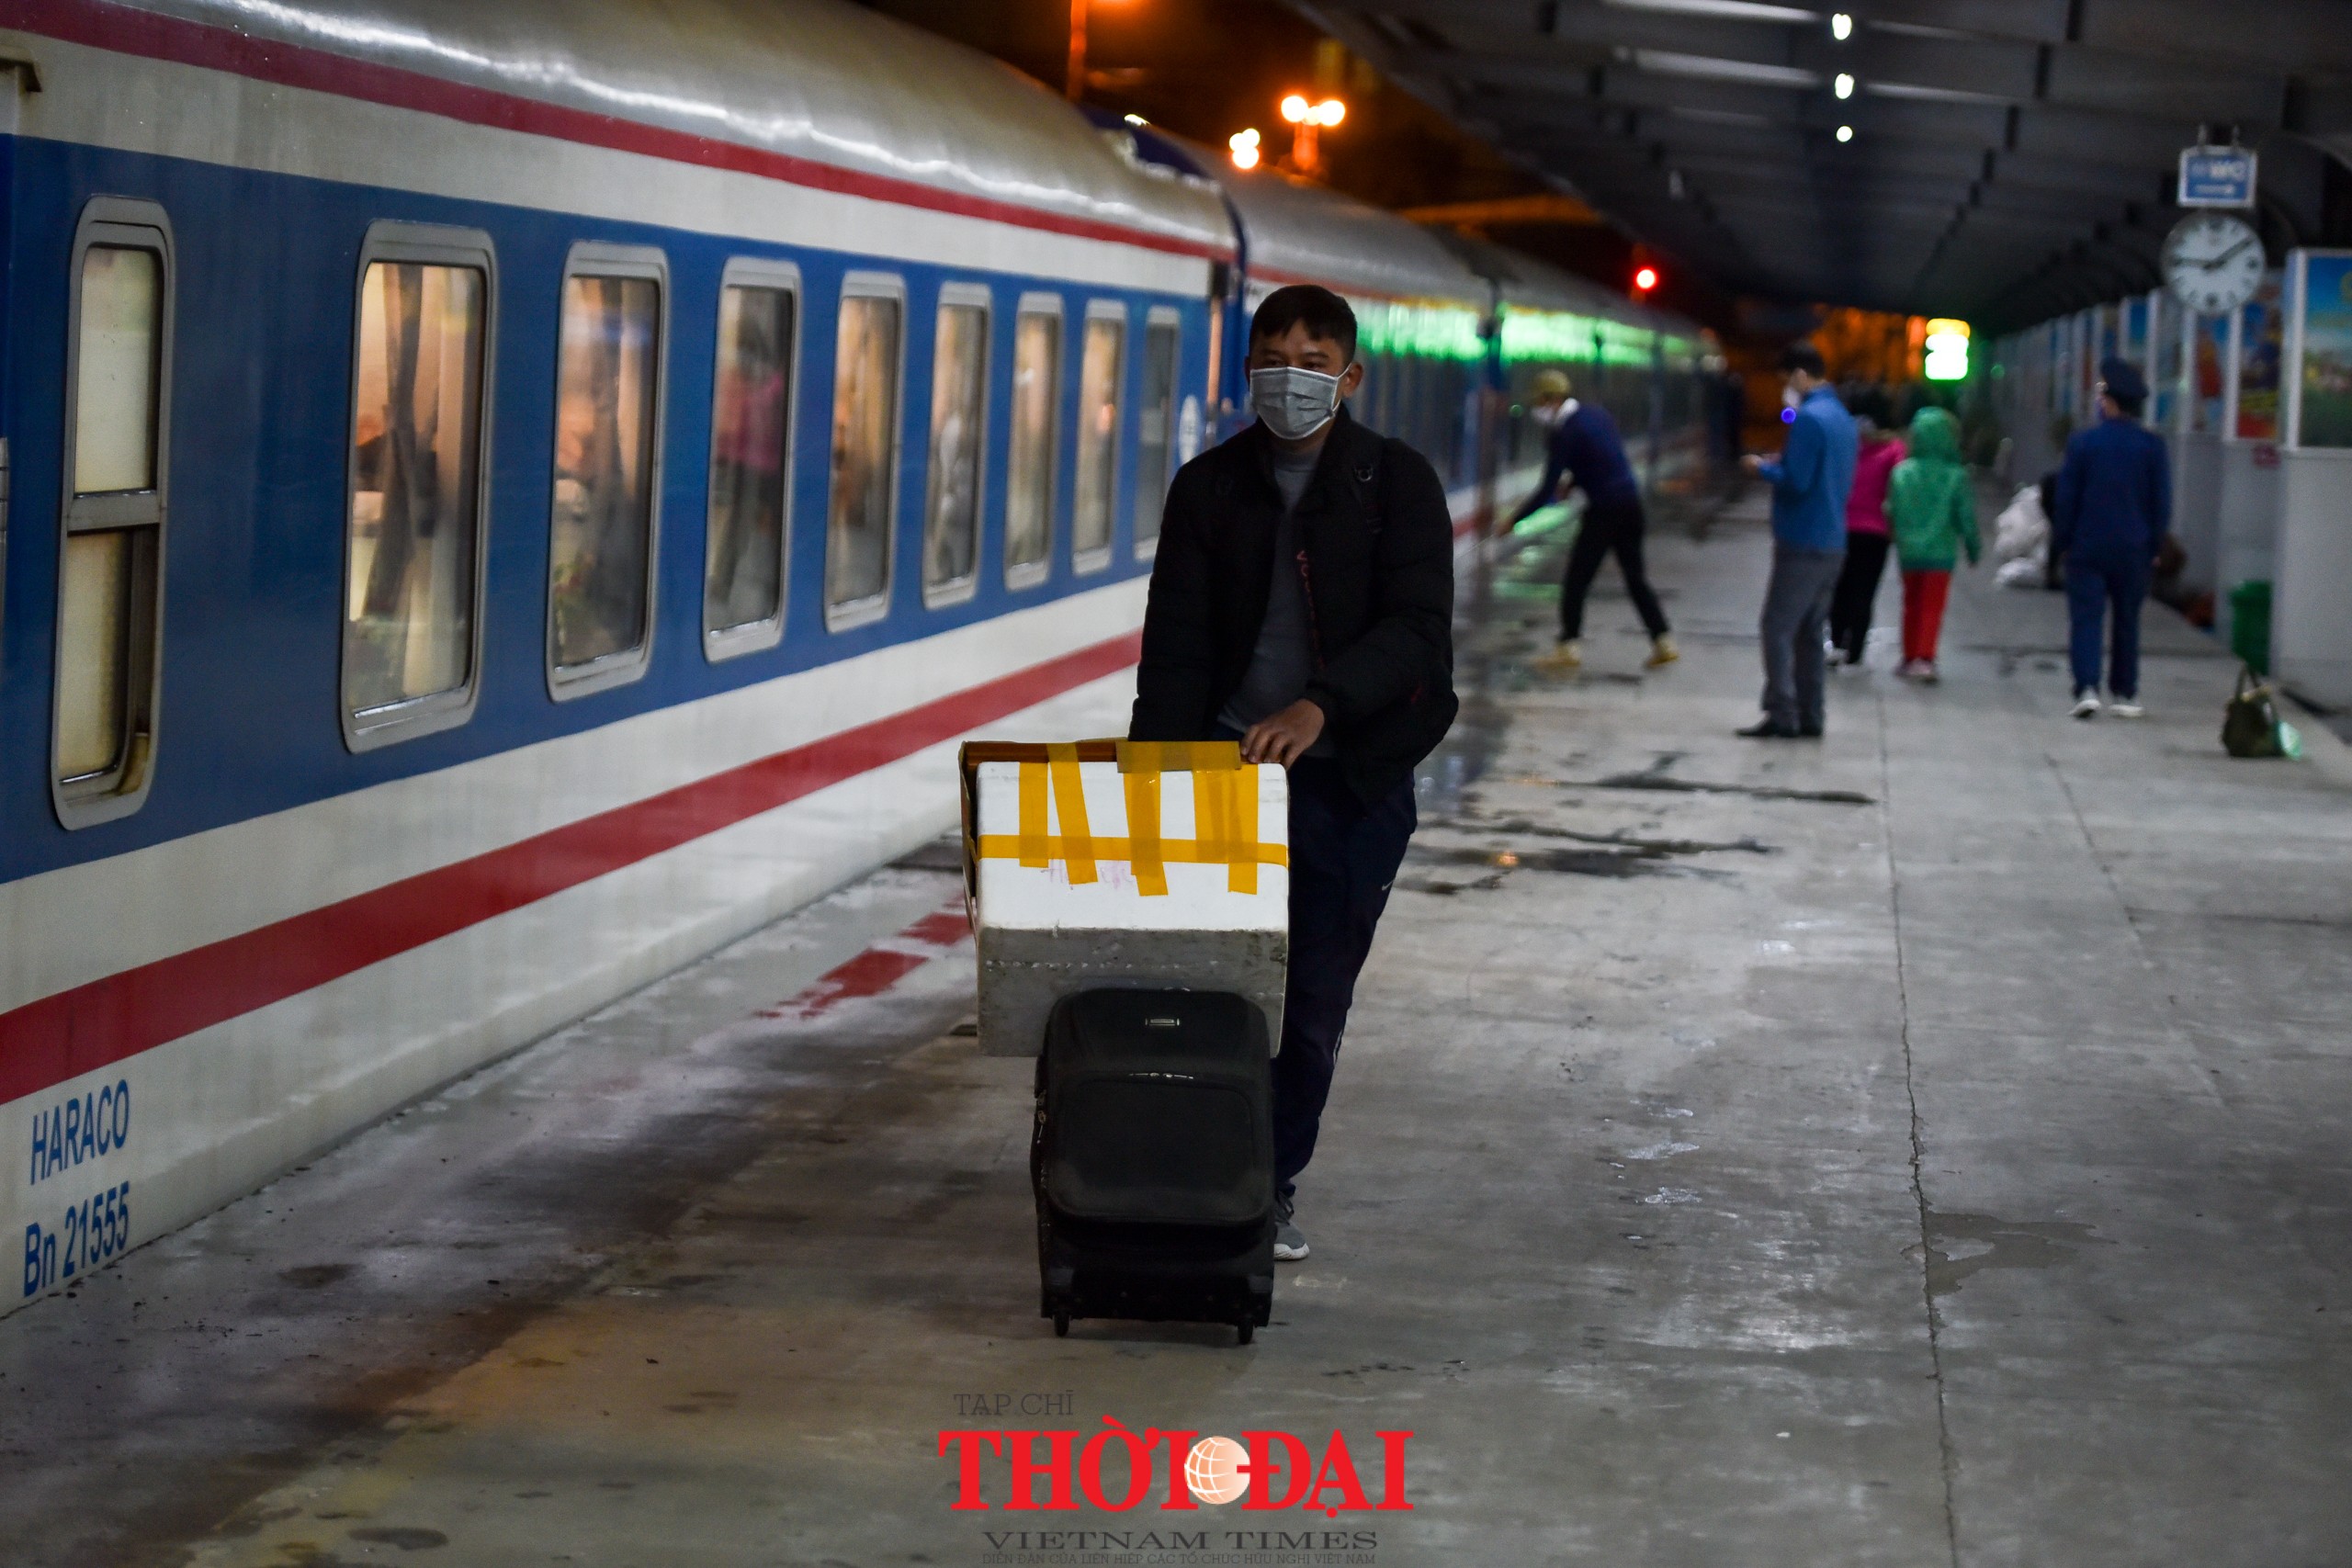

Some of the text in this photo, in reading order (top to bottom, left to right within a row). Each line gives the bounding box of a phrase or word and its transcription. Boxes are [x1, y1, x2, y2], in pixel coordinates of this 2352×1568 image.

[30, 1078, 130, 1185] HARACO
[24, 1180, 130, 1297] Bn 21555
